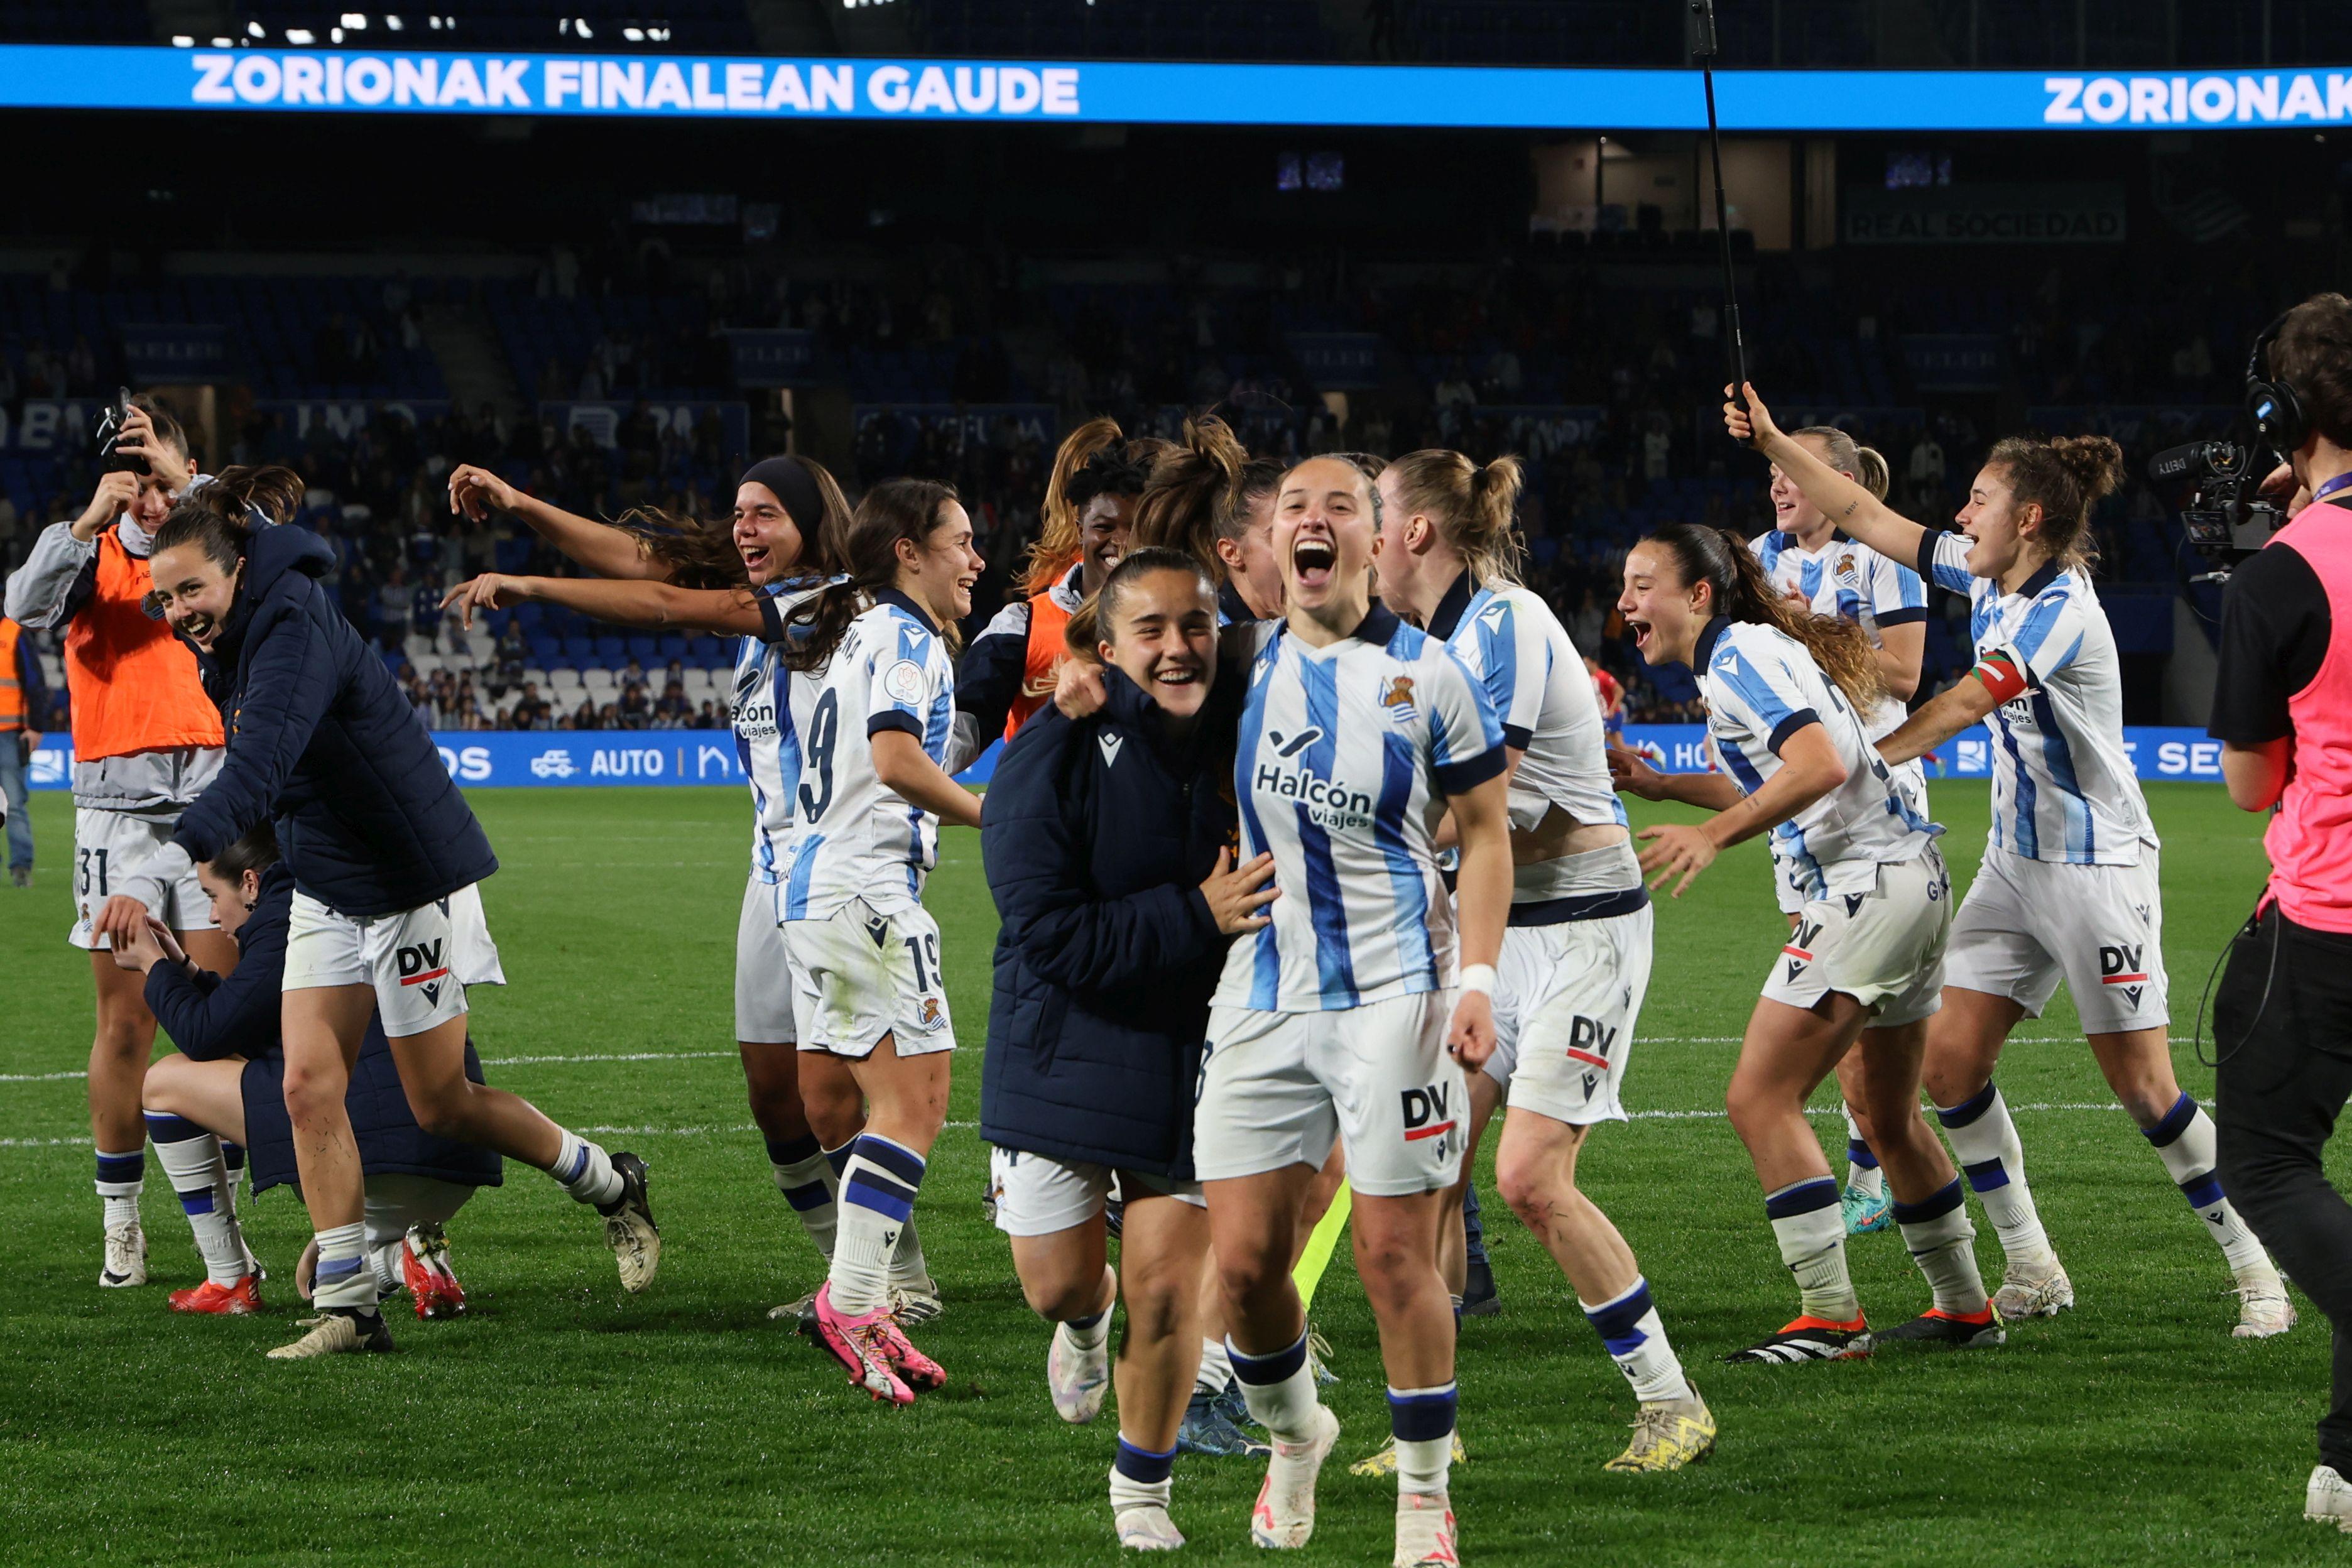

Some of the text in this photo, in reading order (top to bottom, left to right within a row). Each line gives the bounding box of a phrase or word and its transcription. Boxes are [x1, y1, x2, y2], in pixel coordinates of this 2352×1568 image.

[192, 55, 1079, 114] ZORIONAK FINALEAN GAUDE
[2044, 74, 2352, 123] ZORIONAK
[1852, 212, 2118, 238] REAL SOCIEDAD
[741, 724, 776, 738] viajes
[2002, 707, 2032, 724] viajes
[590, 749, 664, 777] AUTO
[1257, 764, 1371, 814] Halcón
[1312, 808, 1368, 830] viajes
[81, 848, 108, 896] 31
[397, 937, 442, 976] DV
[905, 934, 942, 993] 19
[2099, 944, 2143, 975] DV
[1571, 1015, 1616, 1057] DV
[1401, 1081, 1448, 1128] DV
